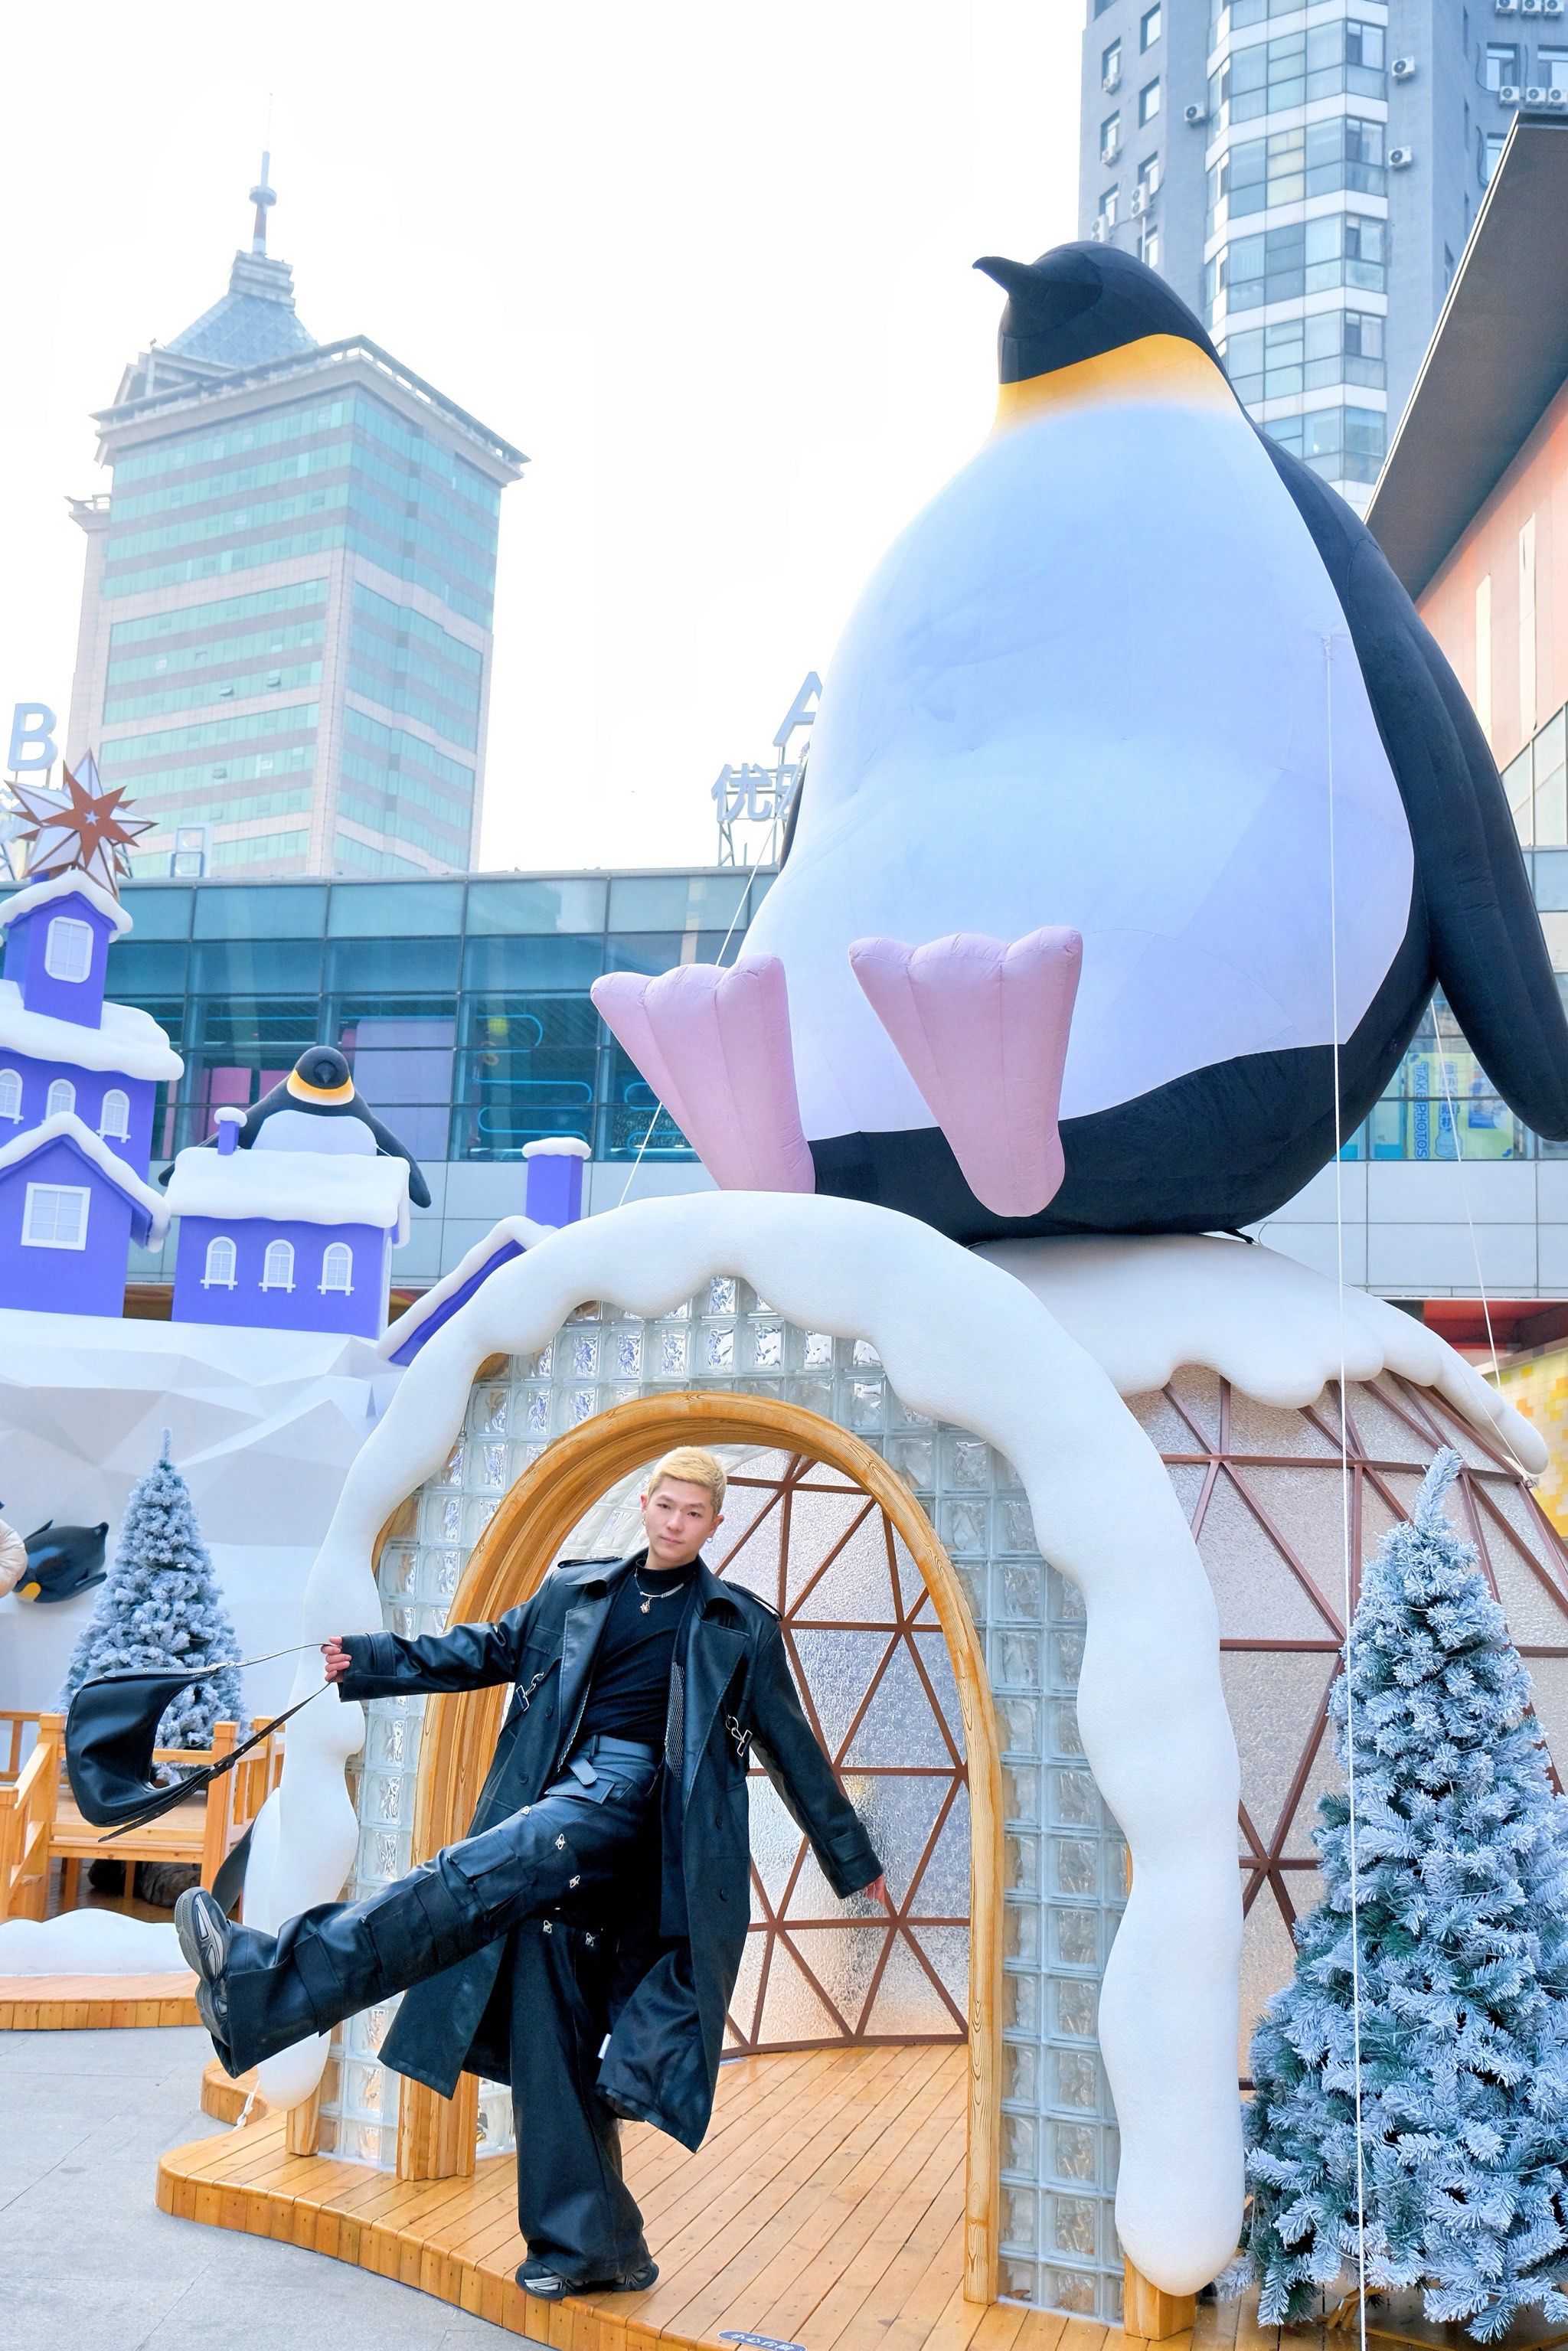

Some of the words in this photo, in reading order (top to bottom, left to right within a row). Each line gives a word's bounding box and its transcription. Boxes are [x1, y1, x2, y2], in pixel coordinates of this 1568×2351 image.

[7, 702, 59, 772] B
[1415, 1063, 1428, 1100] TAKE
[1415, 1103, 1428, 1159] PHOTOS
